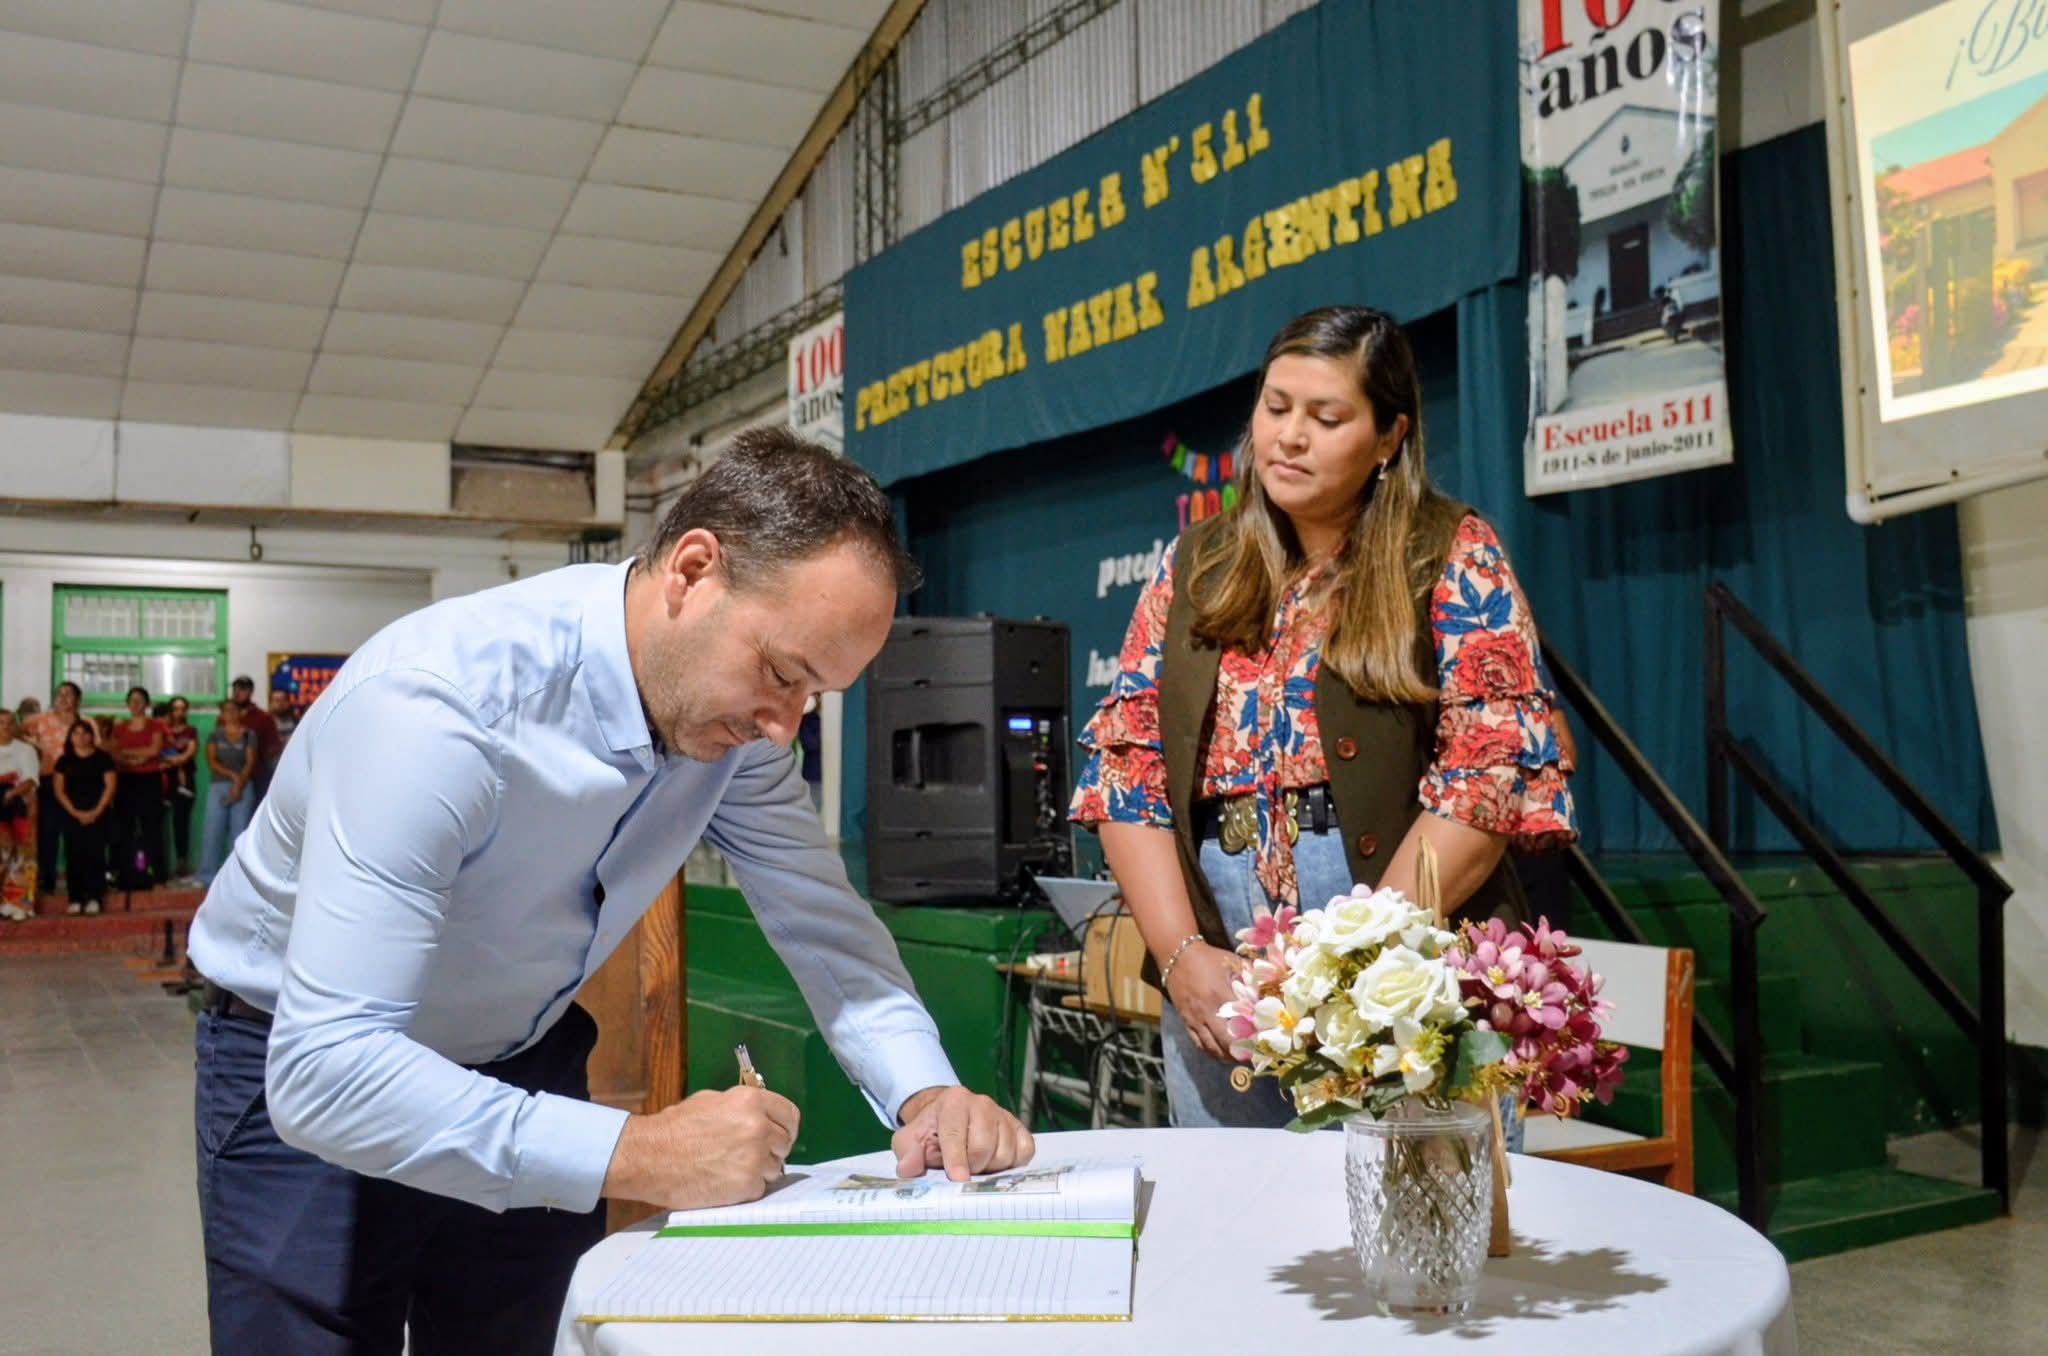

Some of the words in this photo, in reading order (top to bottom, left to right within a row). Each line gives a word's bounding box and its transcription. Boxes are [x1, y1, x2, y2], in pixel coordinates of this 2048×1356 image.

[1538, 7, 1707, 119] años
[961, 171, 1126, 289] ESCUELA
[1190, 92, 1271, 184] 511
[1043, 271, 1165, 364] NAVAL
[1186, 137, 1458, 309] ARGENTINA
[795, 325, 846, 395] 100
[1542, 452, 1597, 476] 1911-8
[1601, 448, 1621, 466] de
[1625, 429, 1714, 466] junio-2011
[1544, 407, 1653, 452] Escuela
[1663, 393, 1713, 429] 511
